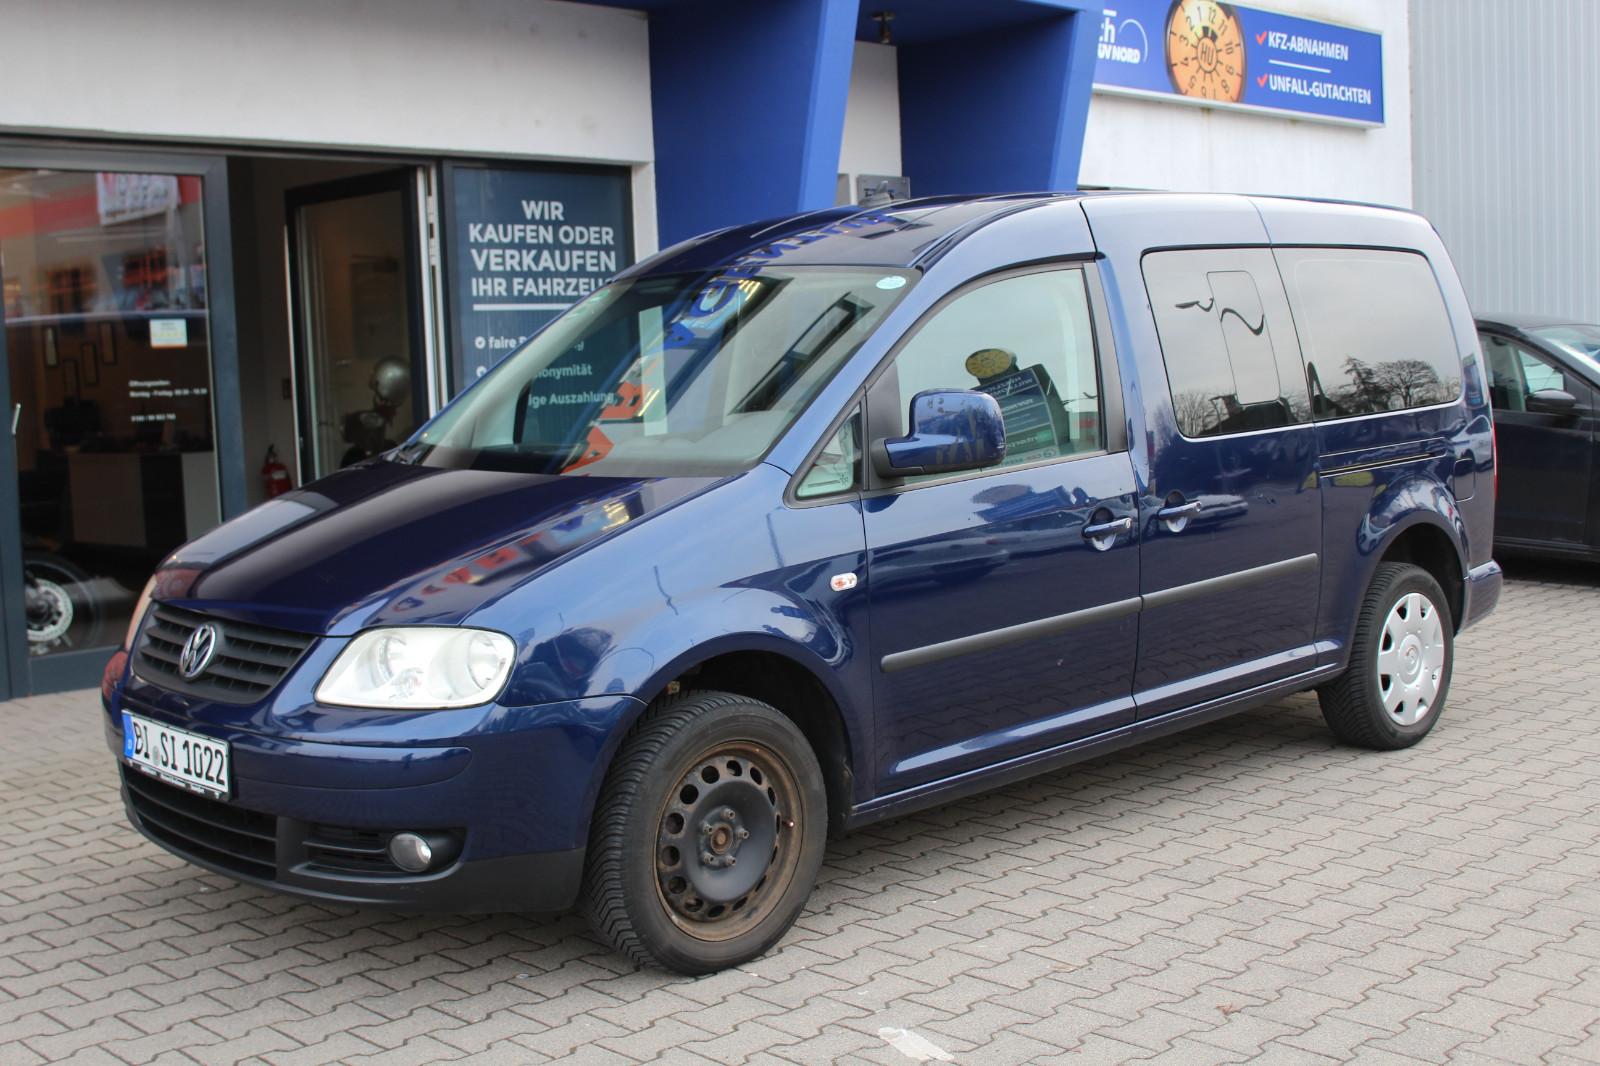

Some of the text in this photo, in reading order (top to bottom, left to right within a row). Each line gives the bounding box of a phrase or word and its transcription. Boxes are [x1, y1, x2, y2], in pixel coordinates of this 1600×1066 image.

[1200, 42, 1214, 66] HU
[1268, 32, 1348, 61] KFZ-ABNAHMEN
[1269, 75, 1371, 105] UNFALL-GUTACHTEN
[522, 200, 564, 220] WIR
[469, 224, 615, 245] KAUFEN ODER
[471, 249, 616, 272] VERKAUFEN
[471, 277, 613, 297] IHR FAHRZEU
[488, 336, 517, 349] faire
[160, 732, 178, 771] SI
[183, 740, 225, 786] 1022
